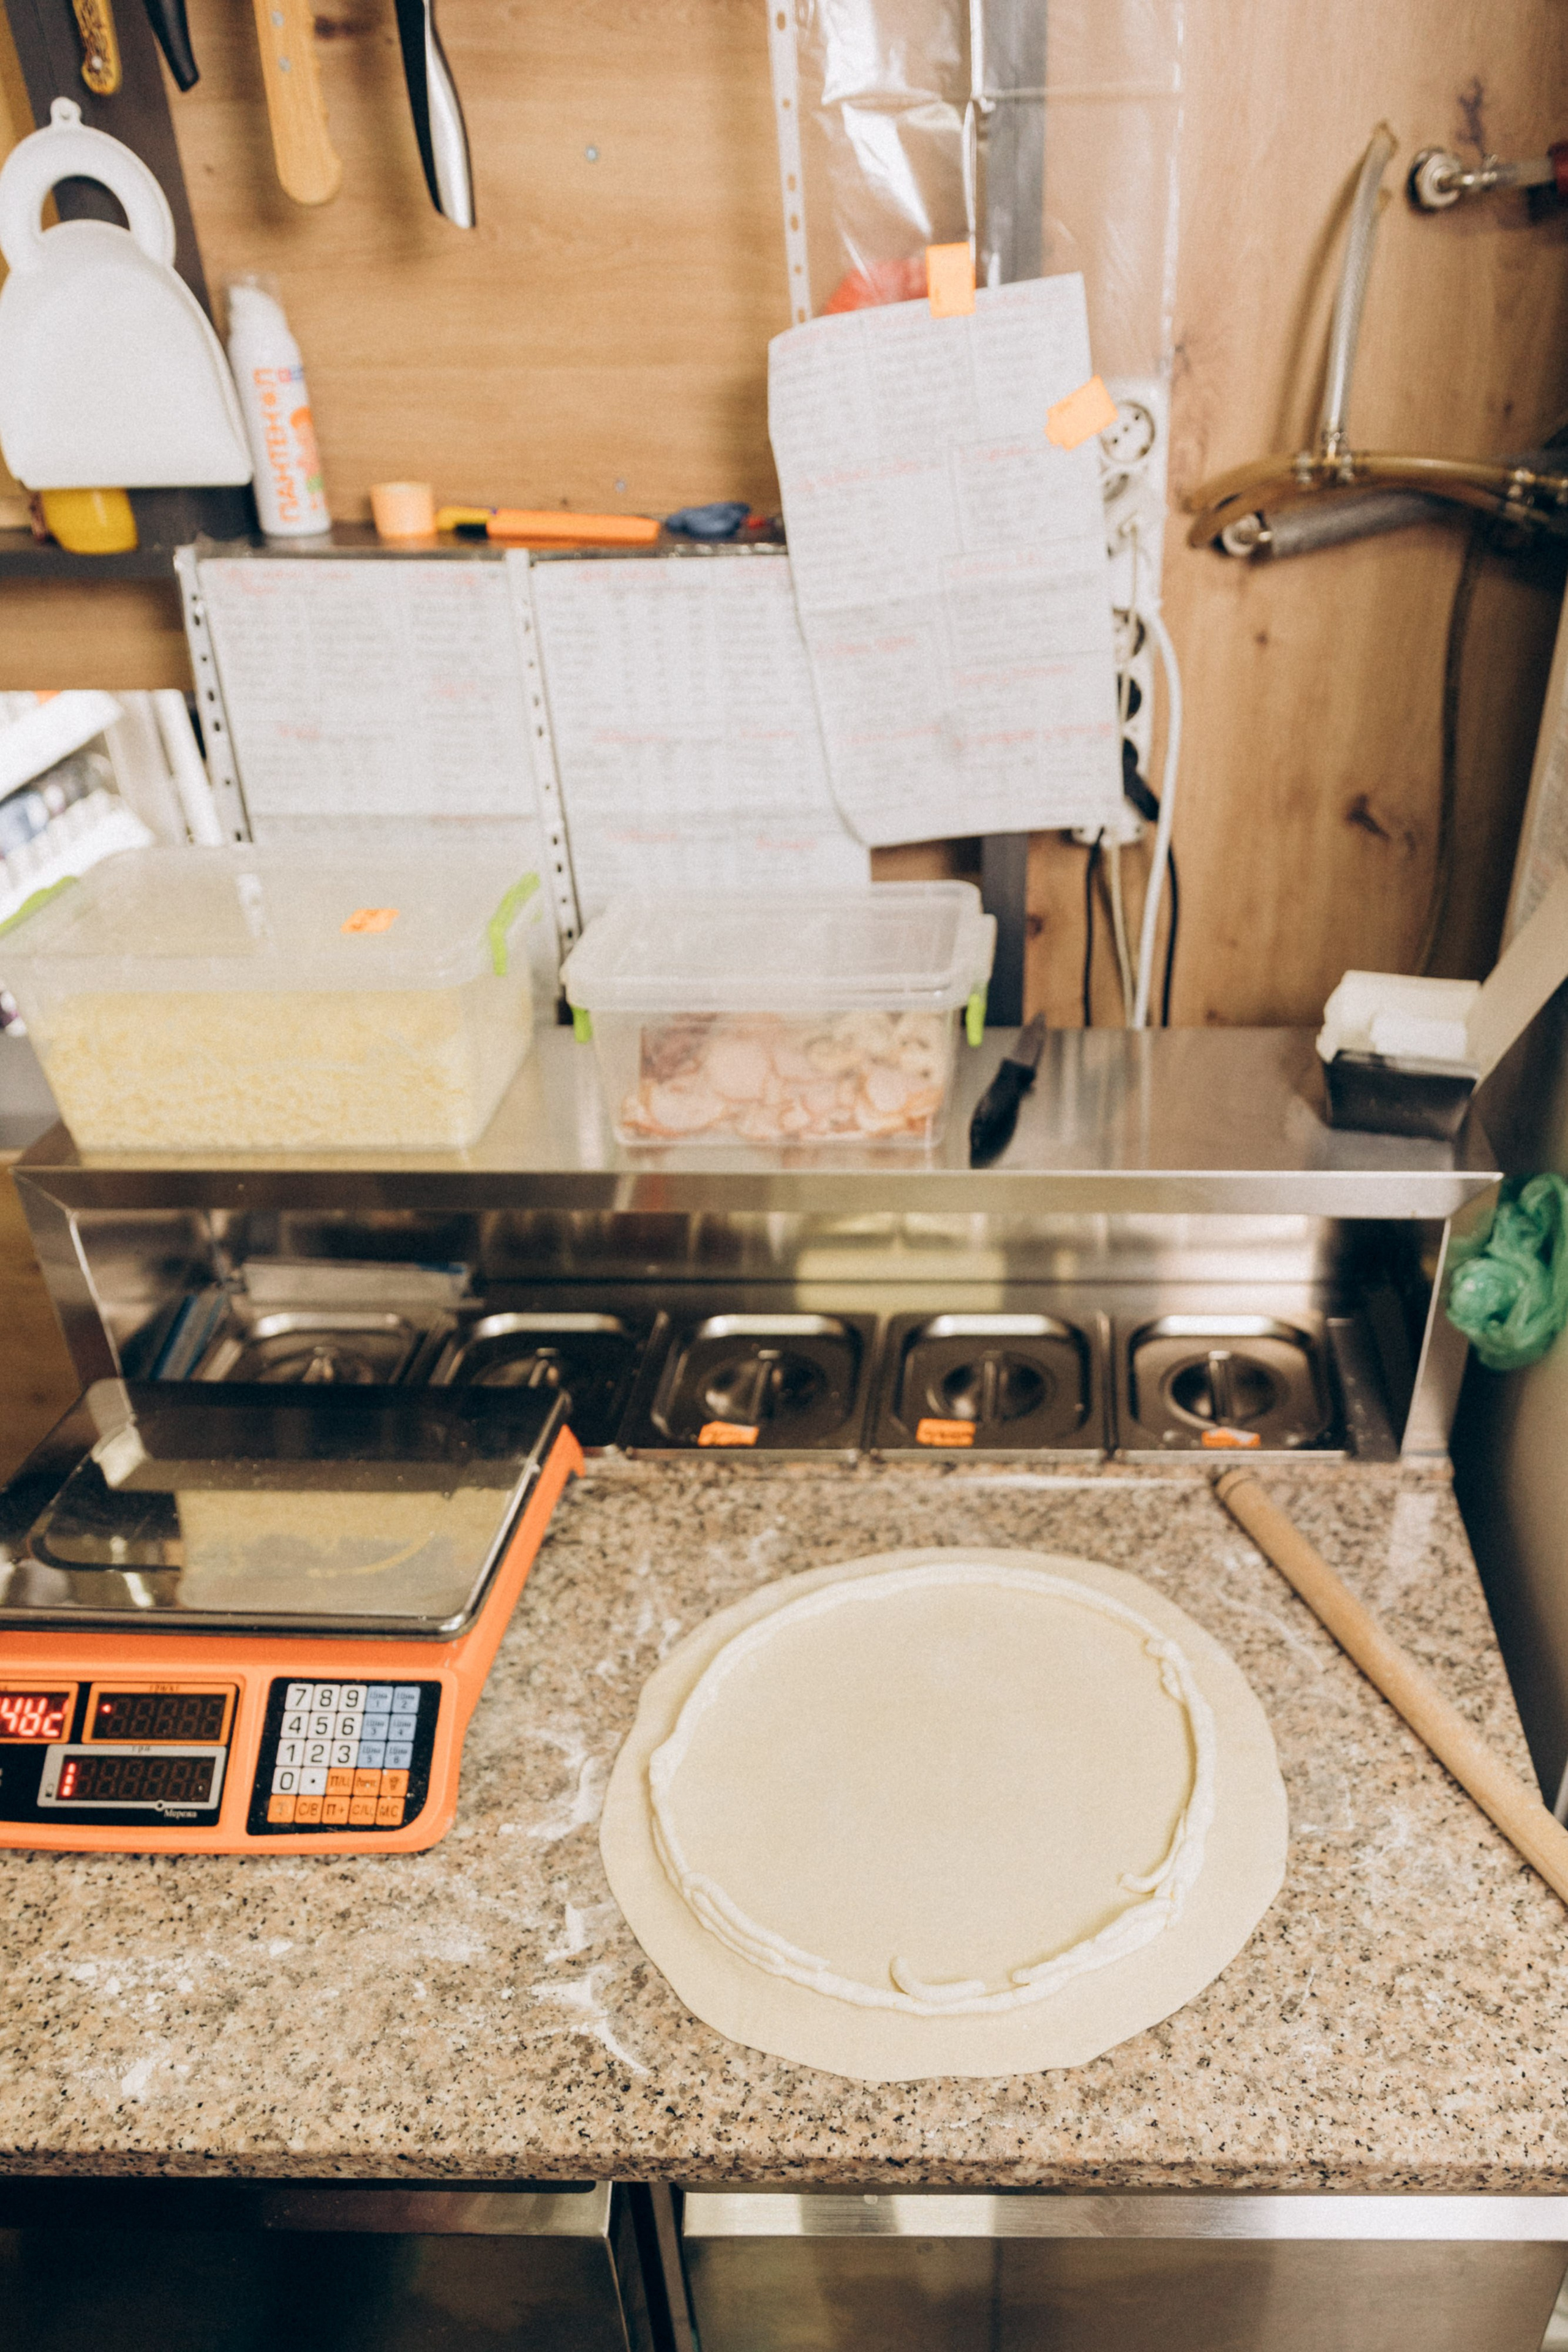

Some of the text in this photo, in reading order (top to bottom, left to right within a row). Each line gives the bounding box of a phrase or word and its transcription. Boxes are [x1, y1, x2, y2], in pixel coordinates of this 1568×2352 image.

[295, 1688, 359, 1708] 7 8 9
[288, 1717, 355, 1735] 4 5 6
[286, 1744, 350, 1763] 1 2 3
[280, 1772, 294, 1790] 0
